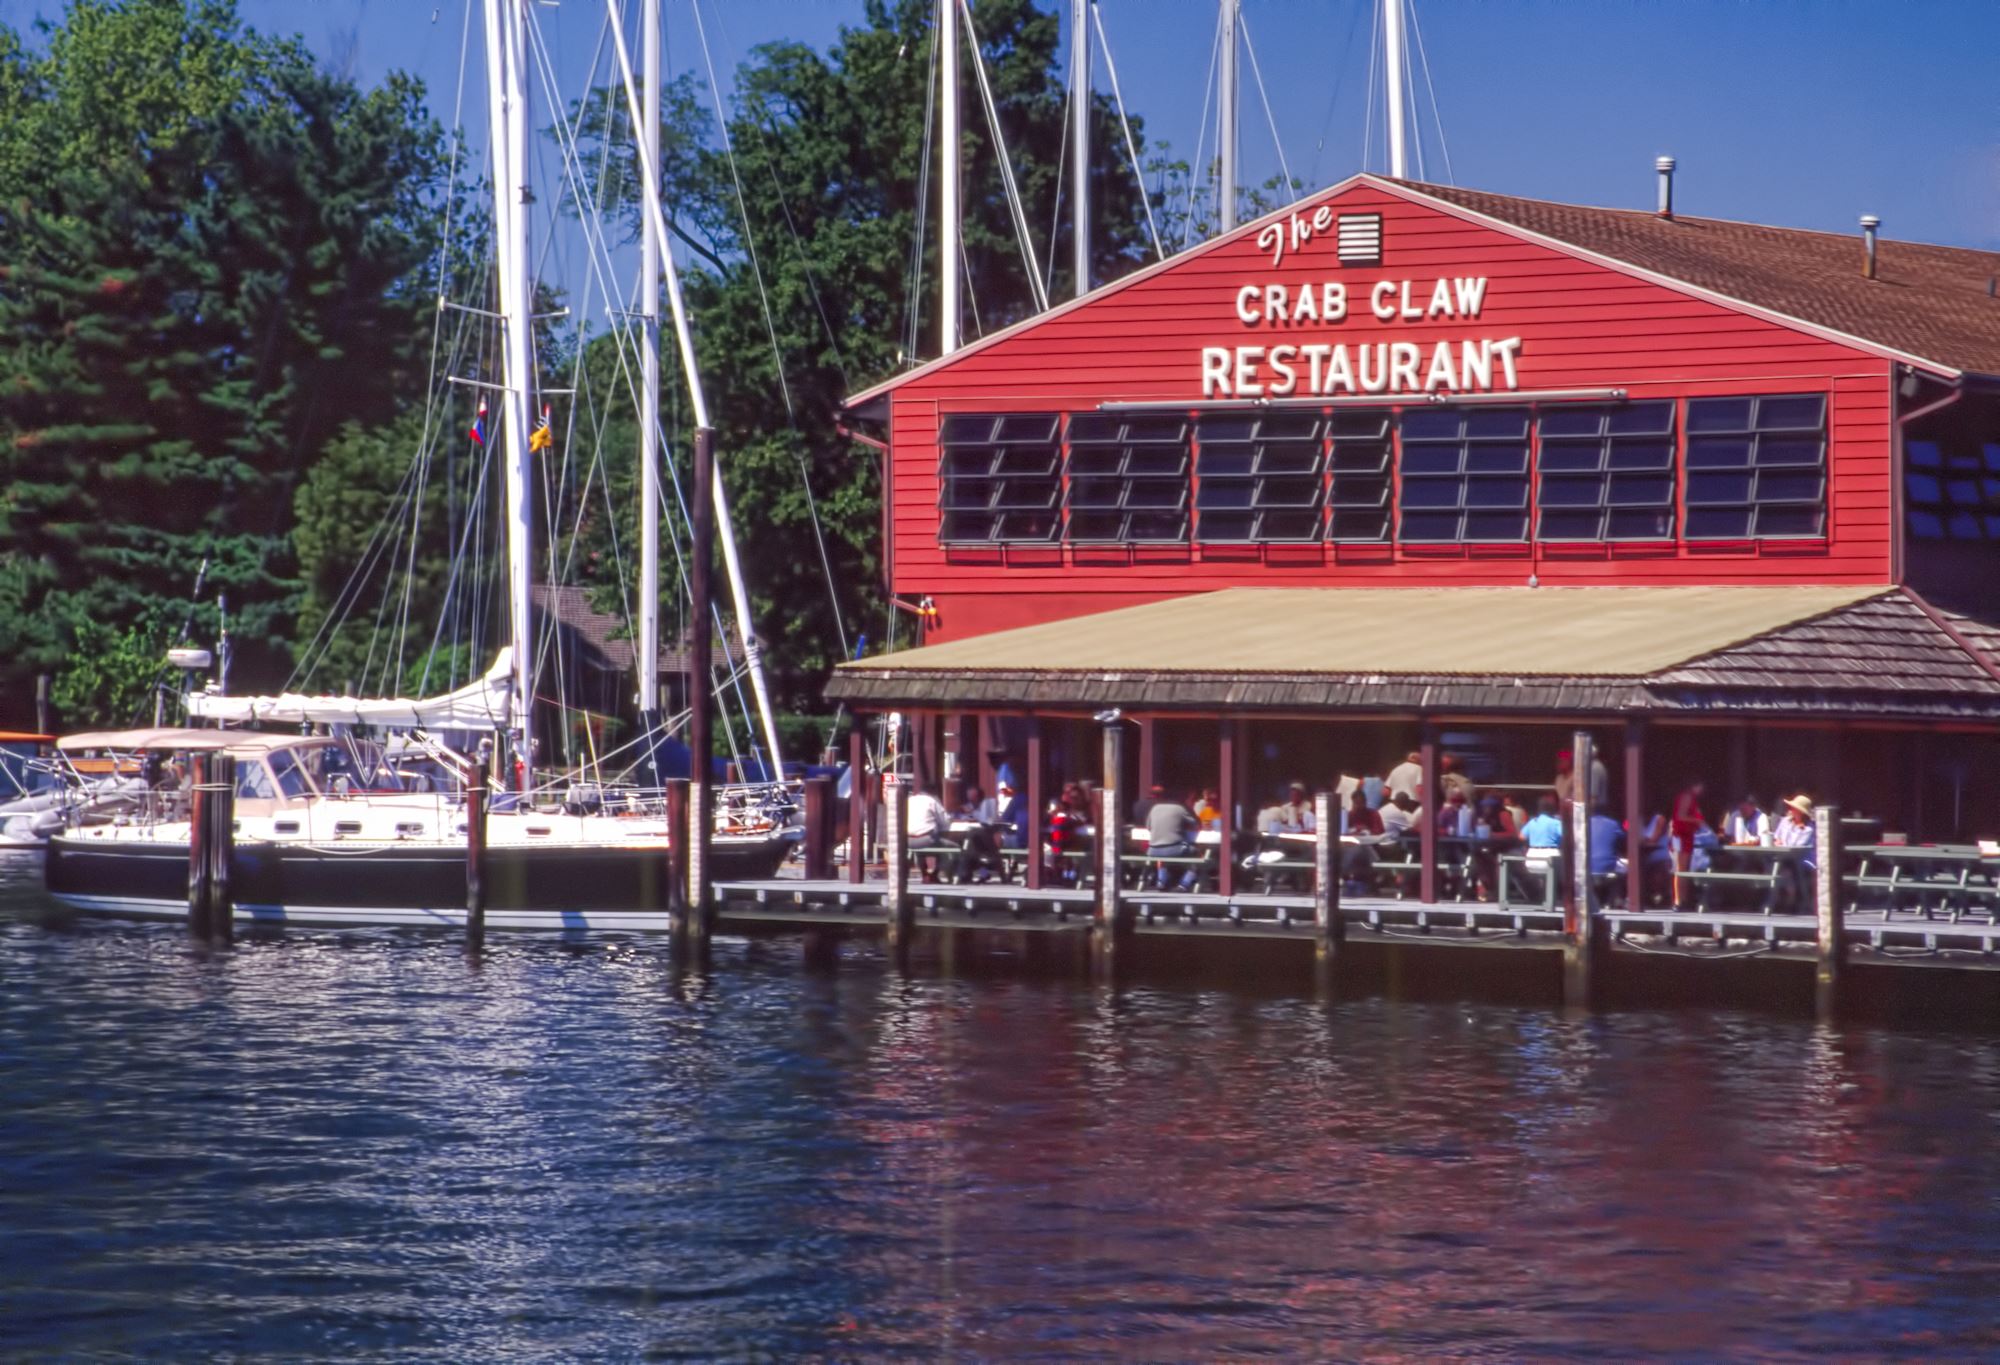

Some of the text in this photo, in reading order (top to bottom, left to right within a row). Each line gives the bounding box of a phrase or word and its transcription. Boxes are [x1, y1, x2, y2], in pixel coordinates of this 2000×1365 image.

[1257, 206, 1332, 266] The
[1236, 277, 1487, 322] CRAB CLAW
[1202, 337, 1522, 396] RESTAURANT
